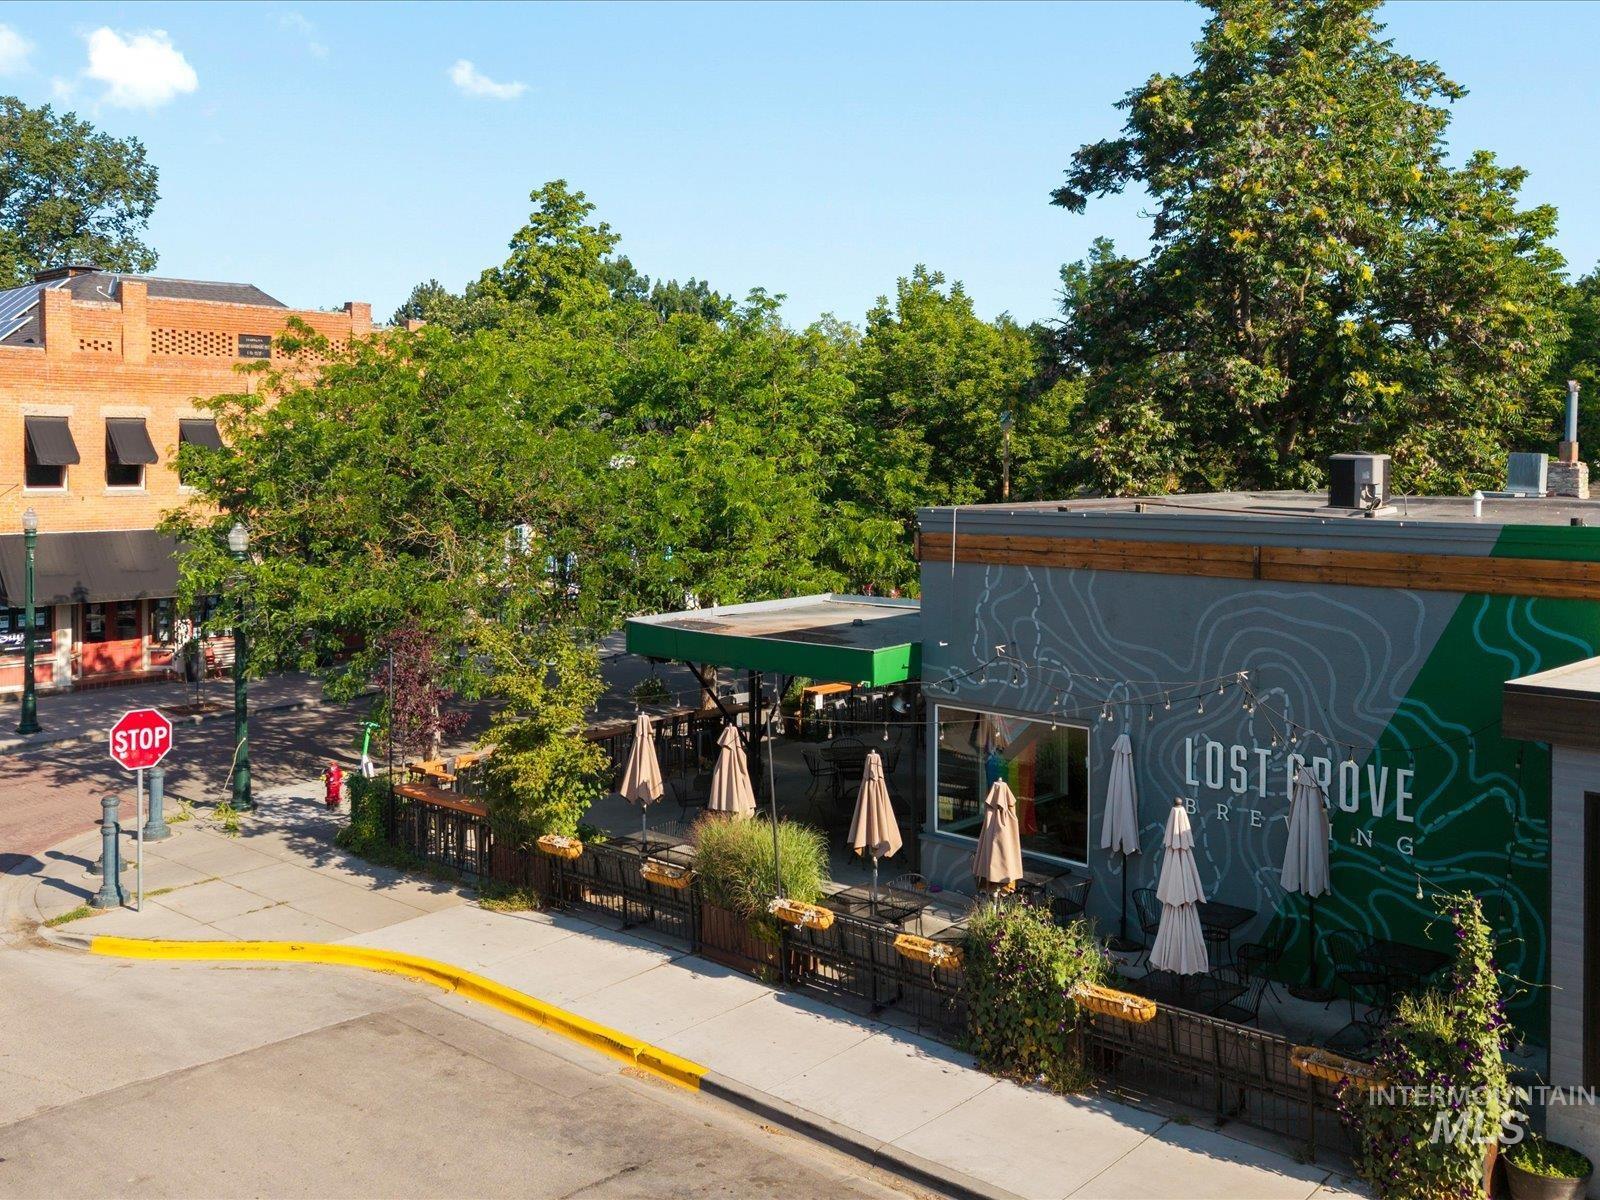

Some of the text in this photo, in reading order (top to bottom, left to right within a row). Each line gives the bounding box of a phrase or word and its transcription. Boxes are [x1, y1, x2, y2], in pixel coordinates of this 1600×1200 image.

[114, 726, 168, 753] STOP
[1185, 737, 1271, 798] LOST
[1184, 798, 1414, 856] BREING
